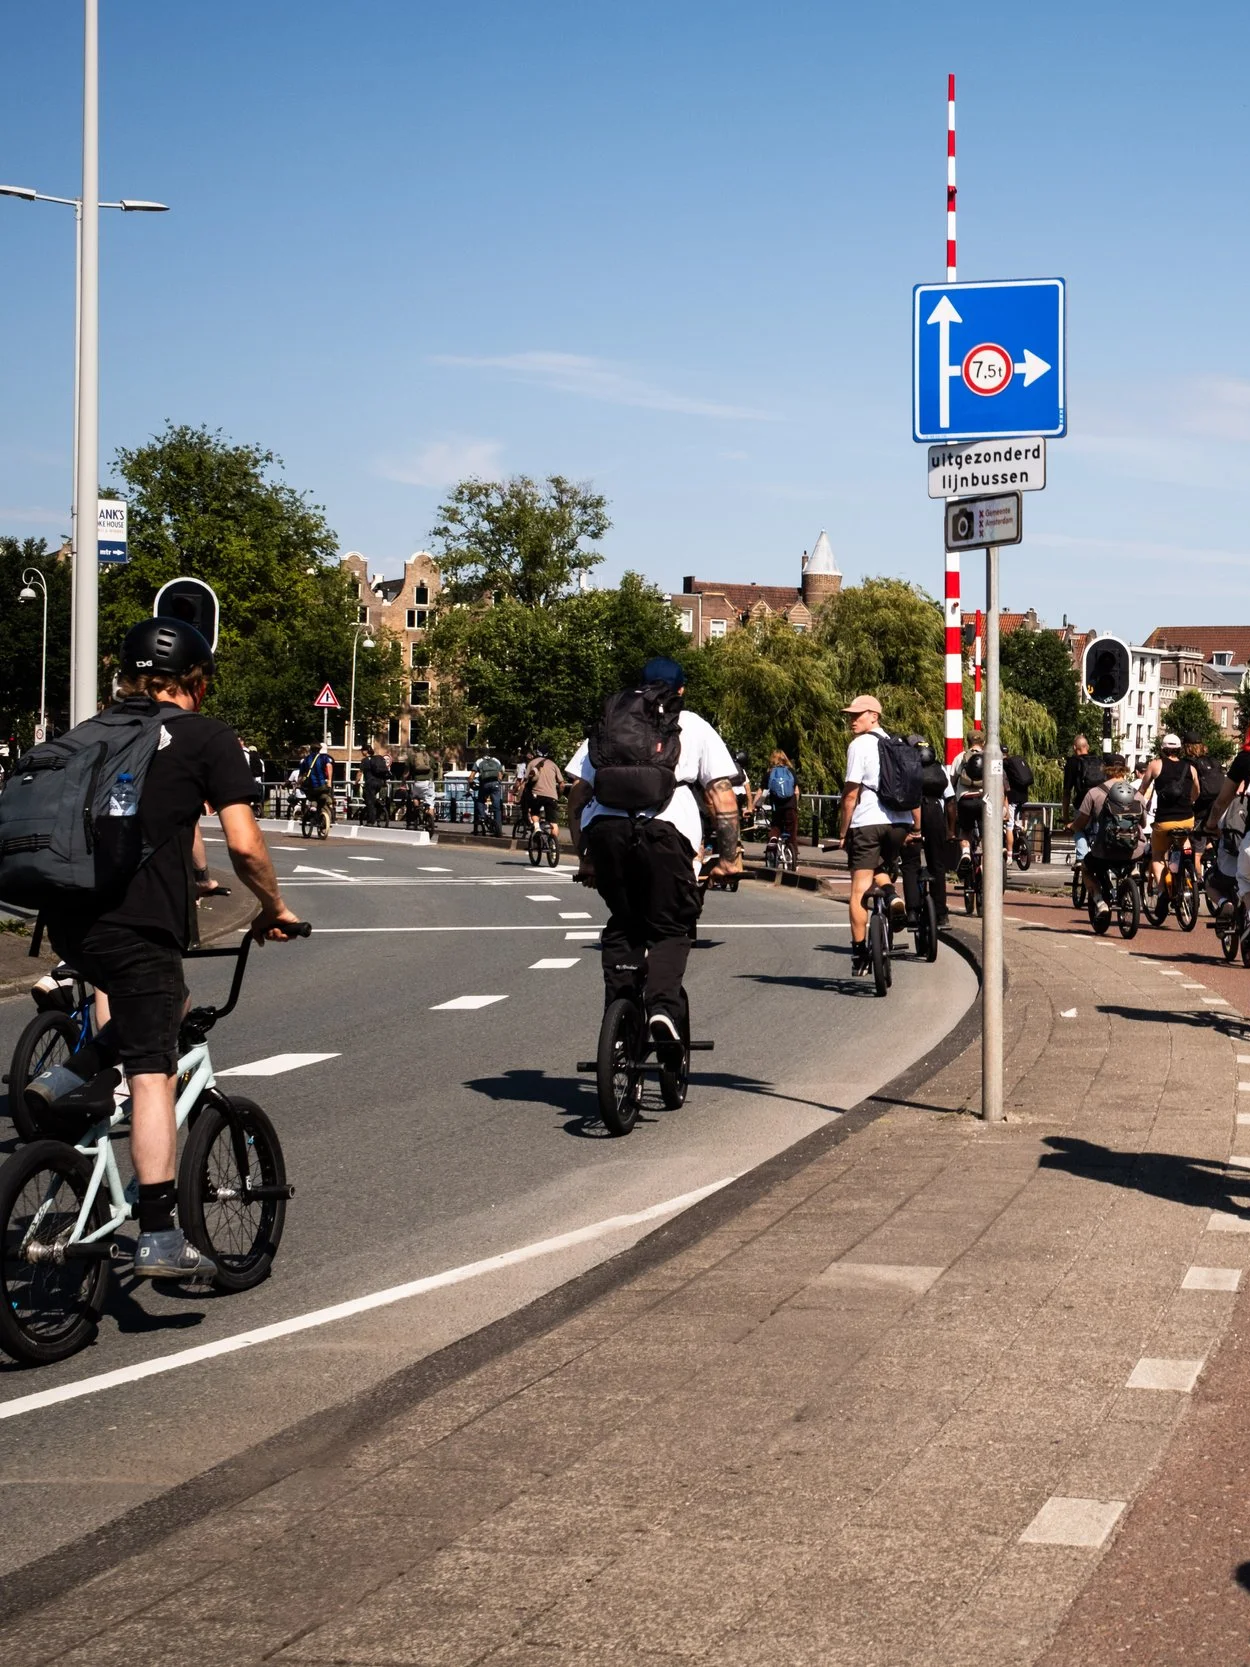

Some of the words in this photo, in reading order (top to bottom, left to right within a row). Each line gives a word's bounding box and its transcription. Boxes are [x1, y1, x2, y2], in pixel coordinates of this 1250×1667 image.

[972, 361, 1002, 379] 7,5t
[931, 444, 1040, 470] uitgezonderd
[942, 471, 1029, 493] lijnbussen
[98, 509, 125, 521] ANK'S
[106, 521, 124, 529] HOUSE
